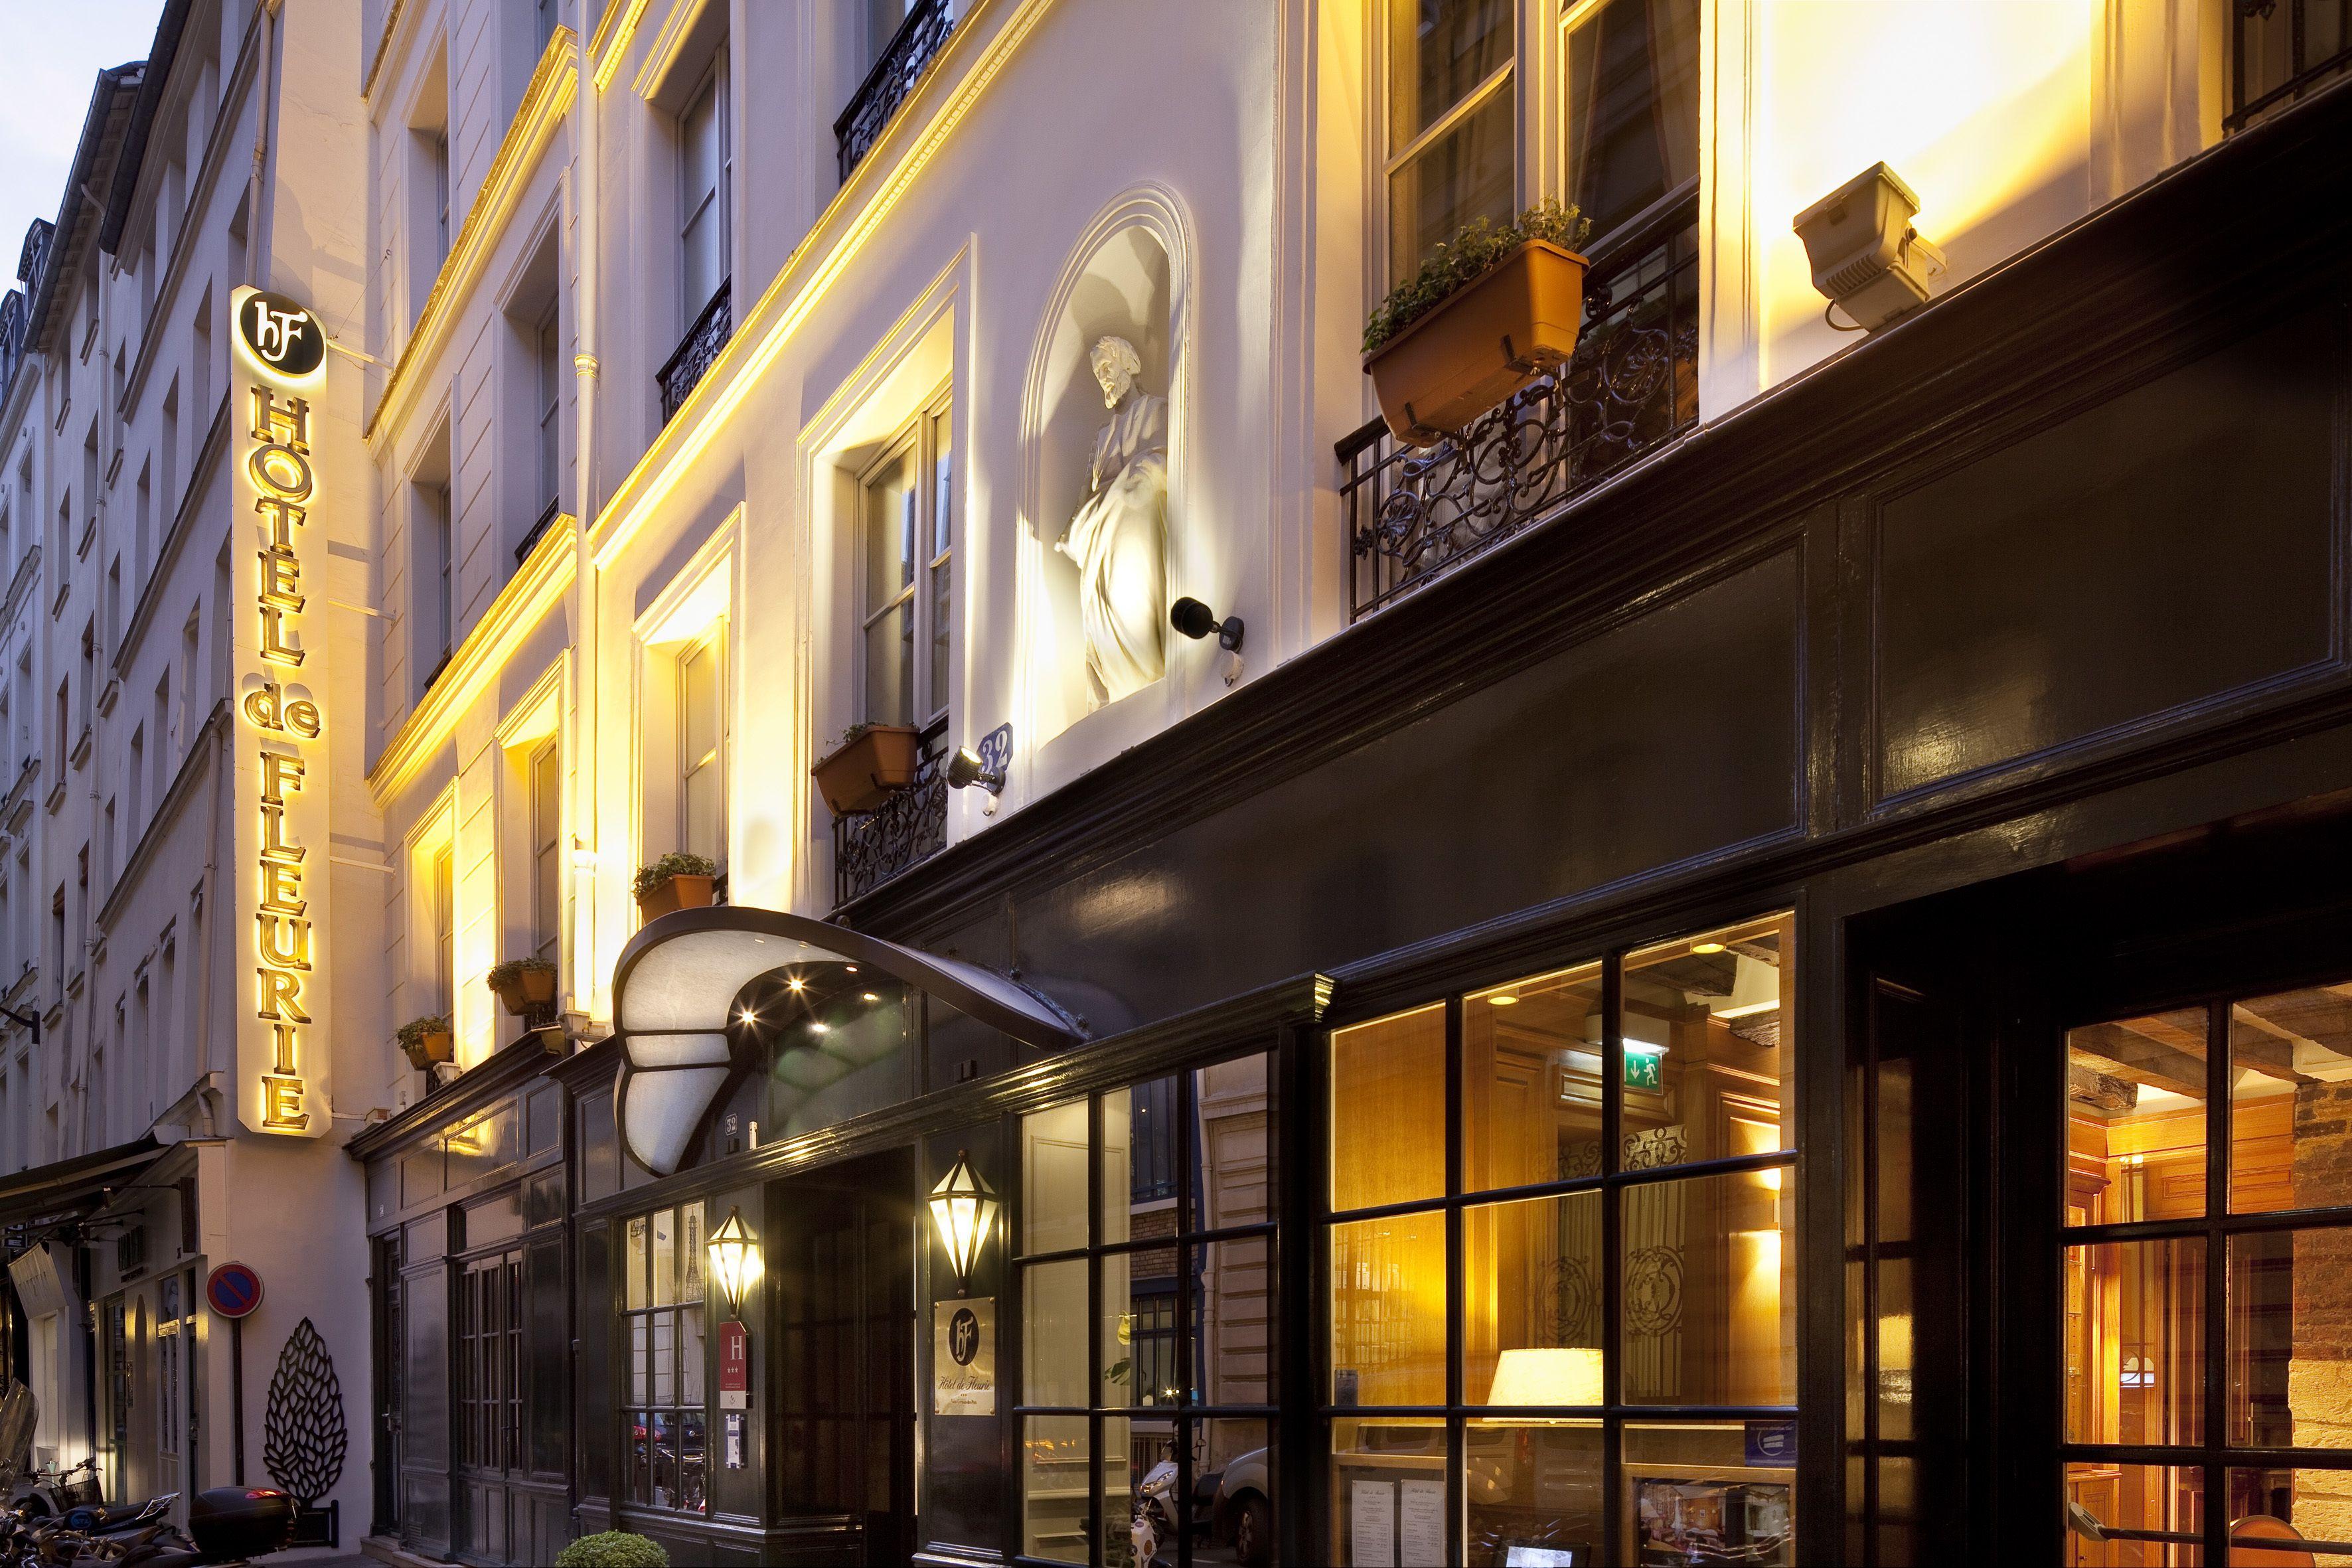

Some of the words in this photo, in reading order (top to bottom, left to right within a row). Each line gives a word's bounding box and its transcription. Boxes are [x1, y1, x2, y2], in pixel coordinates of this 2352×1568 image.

[249, 384, 312, 667] HOTEL
[244, 682, 321, 739] de
[982, 730, 1008, 774] 32
[256, 751, 312, 1131] FLEURIE
[727, 1117, 736, 1133] 32
[730, 1335, 743, 1360] H
[957, 1377, 965, 1390] de
[965, 1375, 990, 1390] Fleurie
